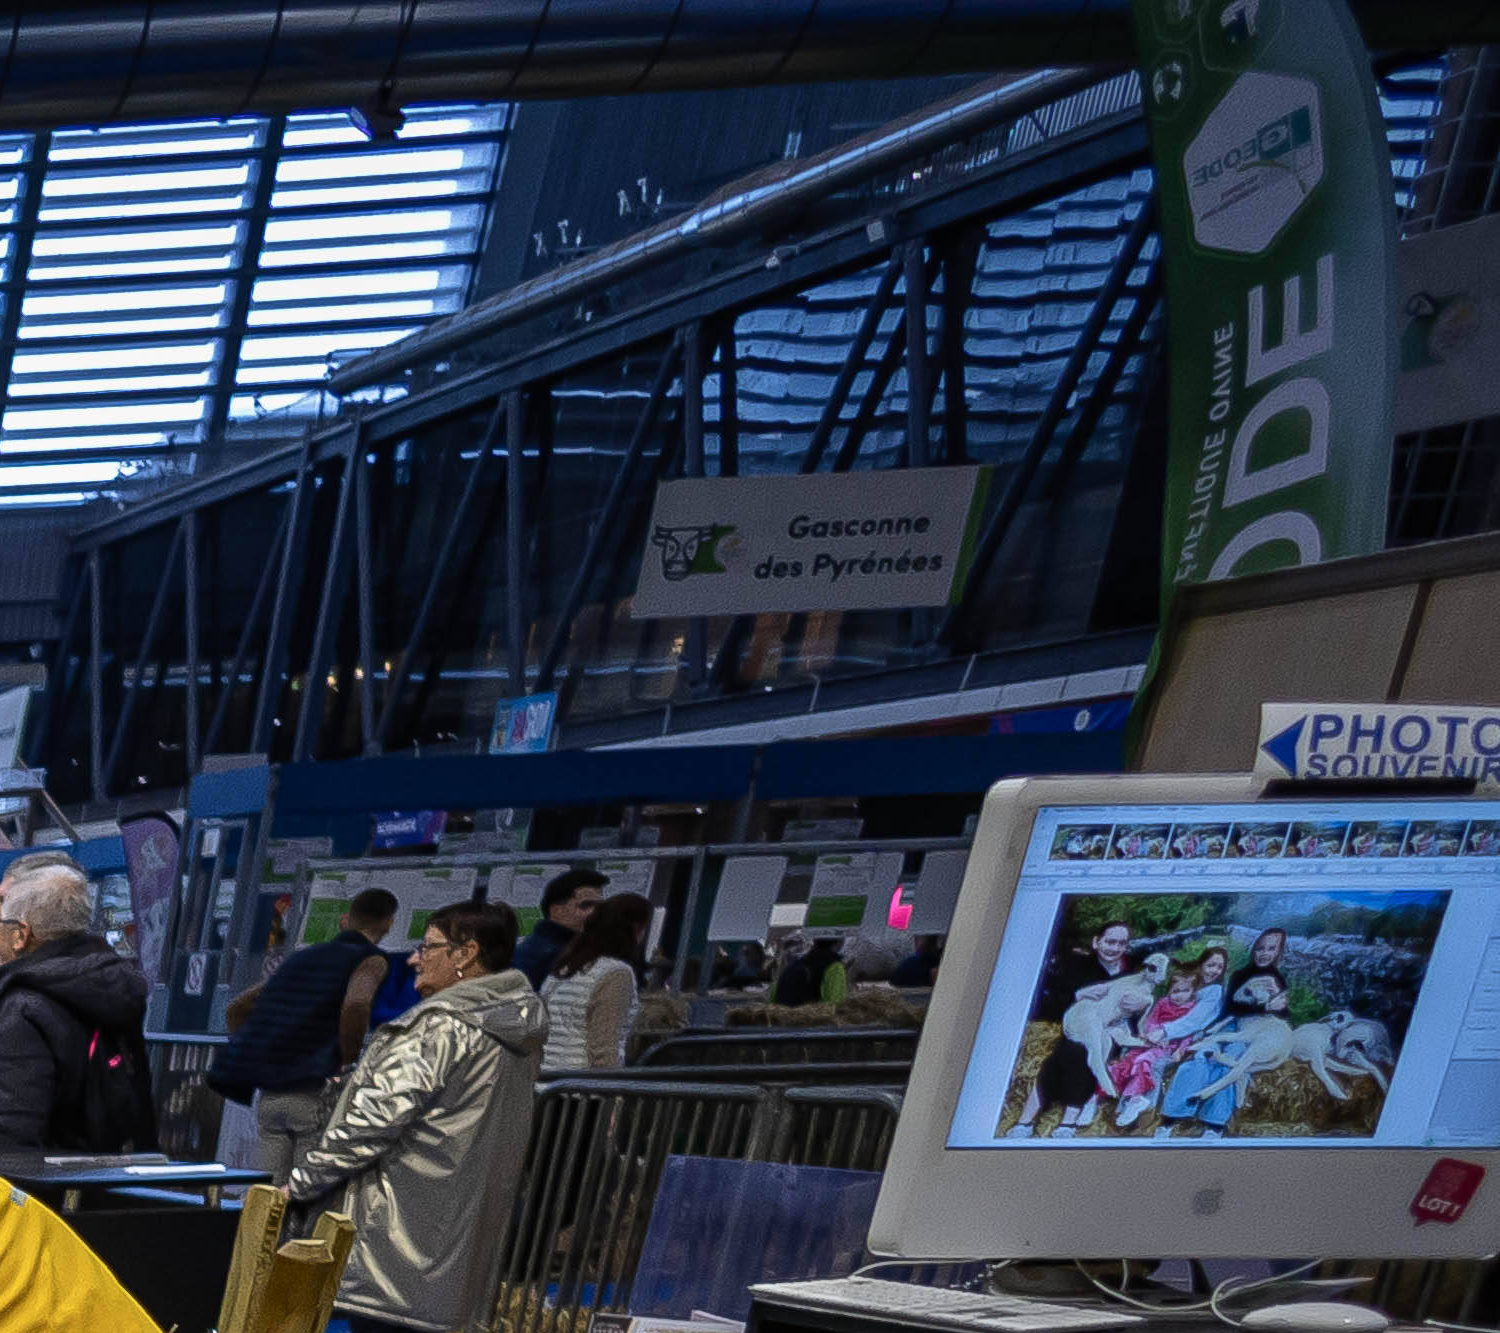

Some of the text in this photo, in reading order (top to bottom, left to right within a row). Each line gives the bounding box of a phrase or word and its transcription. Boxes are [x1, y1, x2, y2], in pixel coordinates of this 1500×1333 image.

[787, 513, 932, 541] Gasconne
[753, 549, 944, 584] des Pyrénées
[1308, 713, 1500, 756] PHOTO
